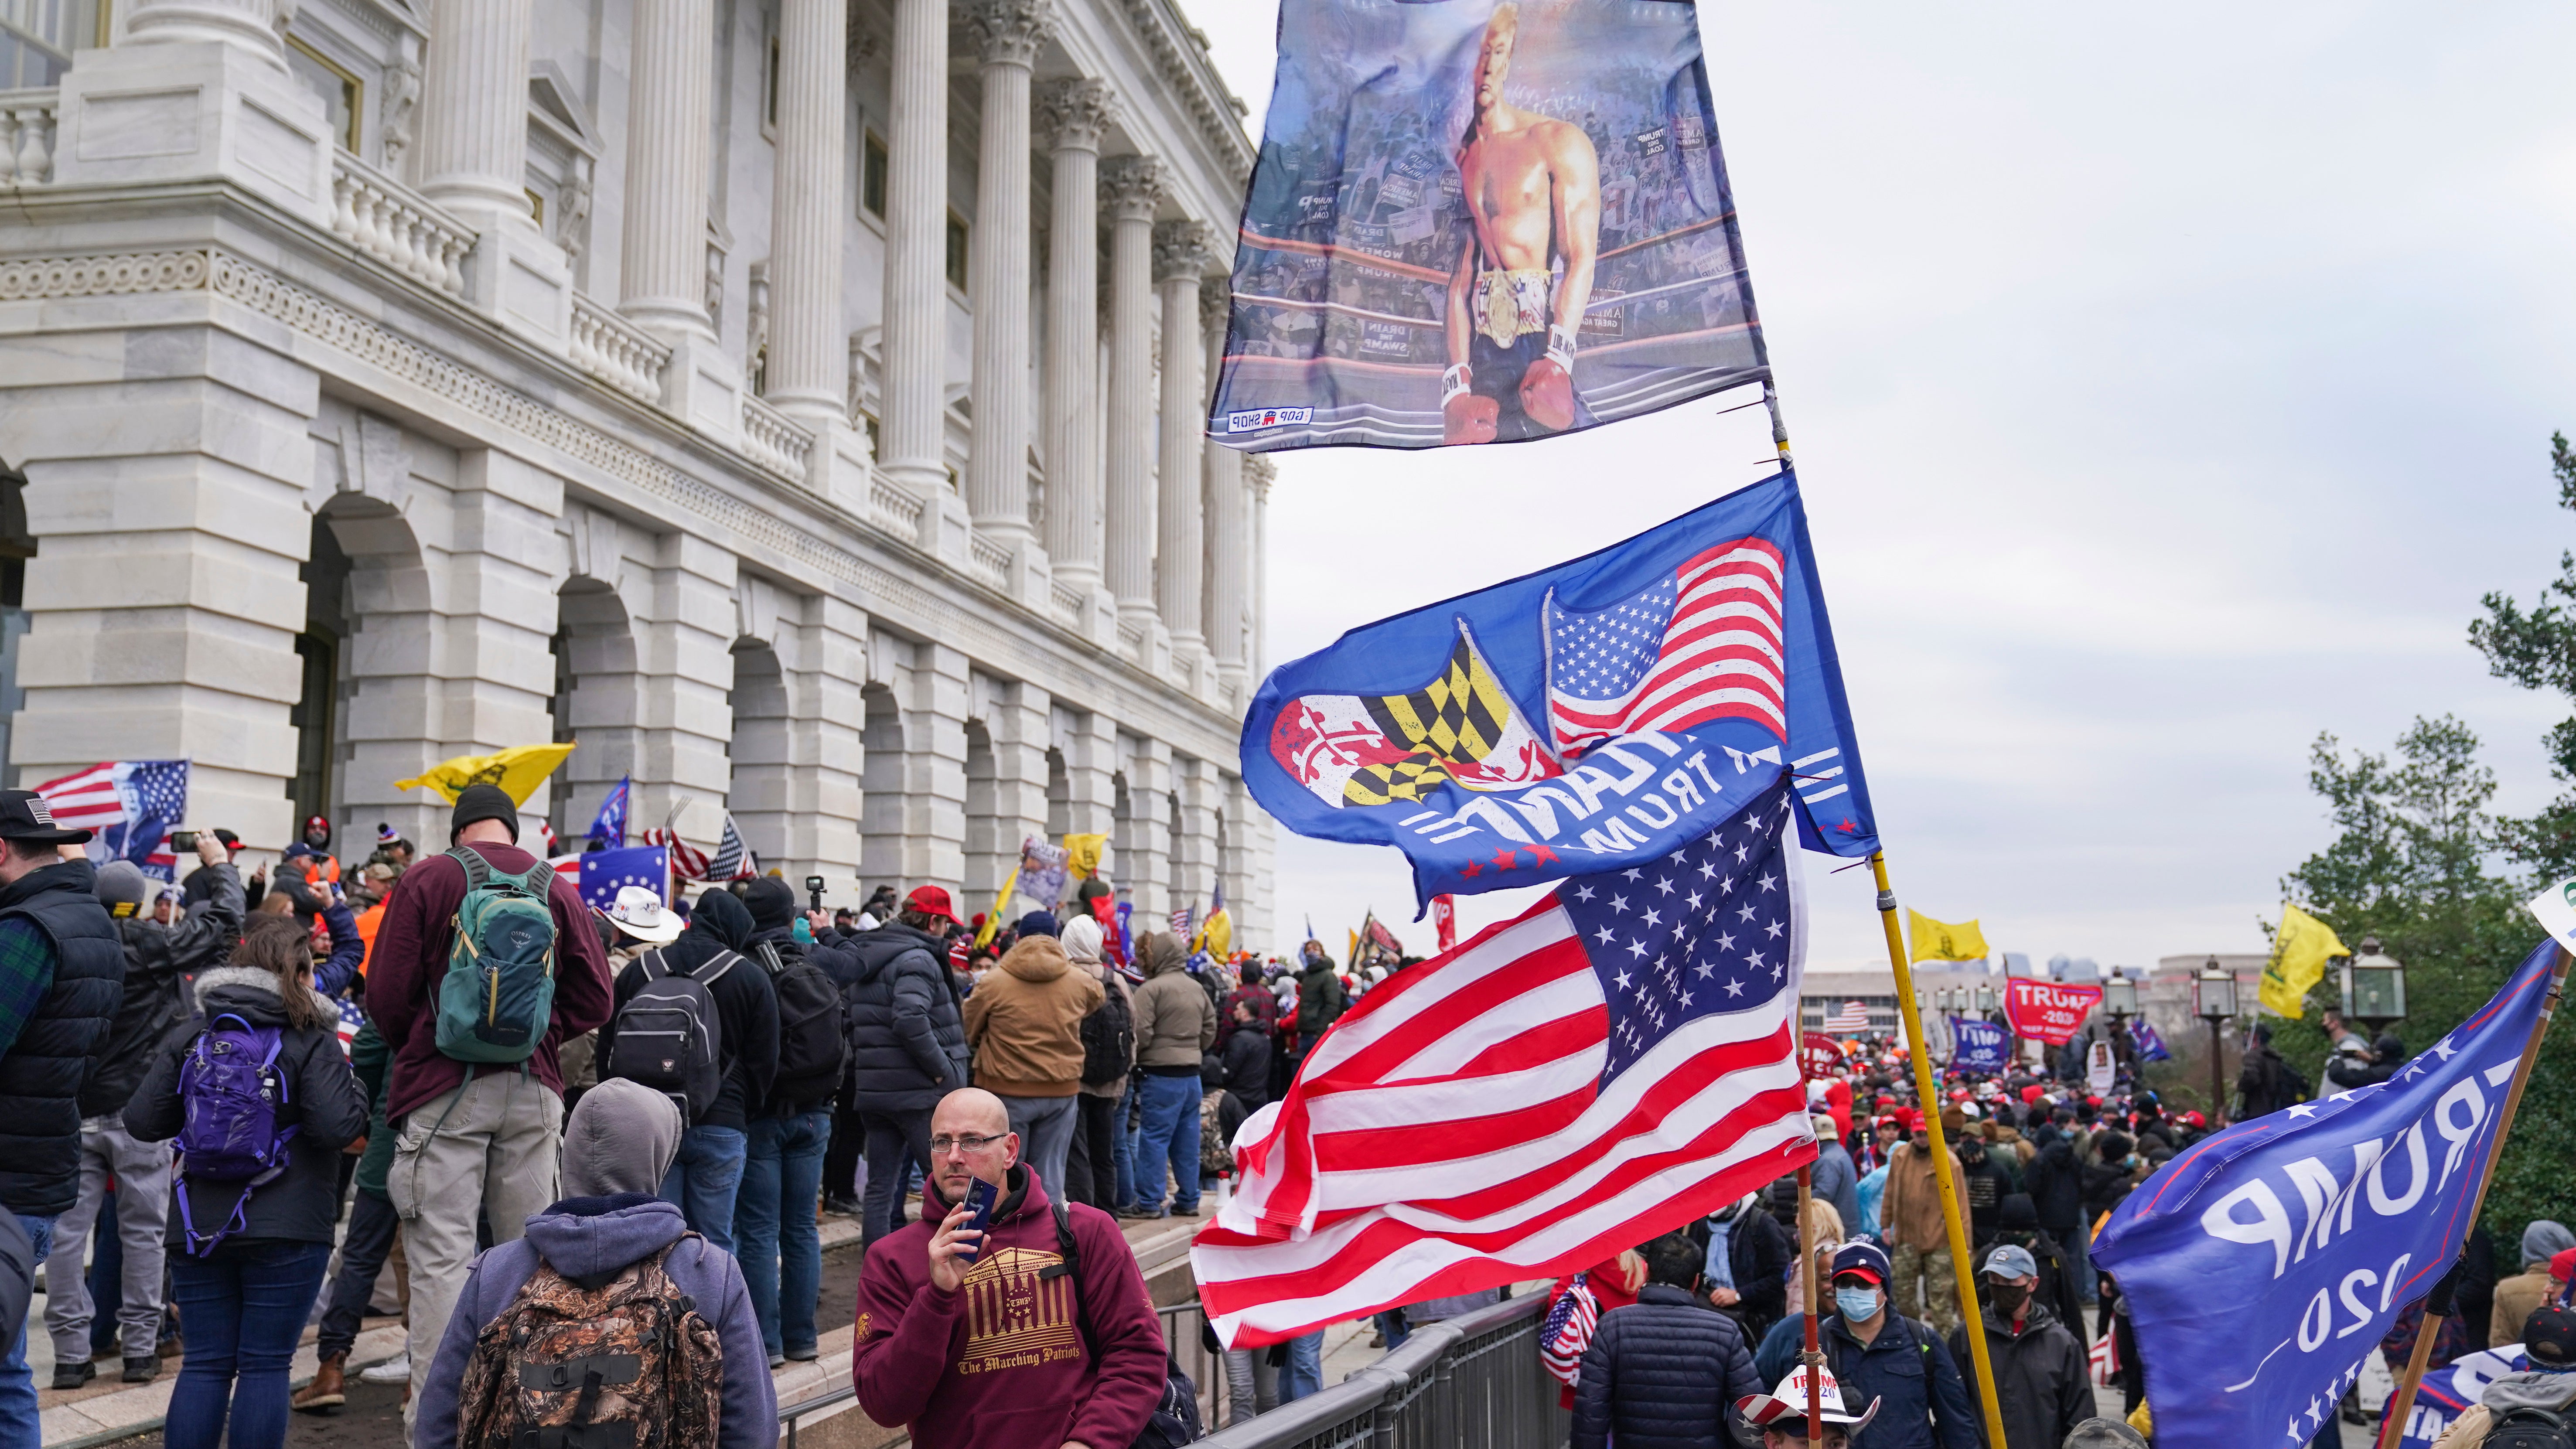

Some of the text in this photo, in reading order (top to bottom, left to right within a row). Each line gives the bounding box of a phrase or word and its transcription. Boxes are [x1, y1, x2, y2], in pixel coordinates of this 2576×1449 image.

[511, 931, 532, 940] OSPREY
[977, 1271, 996, 1279] EQUAL
[958, 1346, 1080, 1374] The Marching Patriots
[1791, 1375, 1837, 1390] TRMP
[1801, 1387, 1835, 1398] 220
